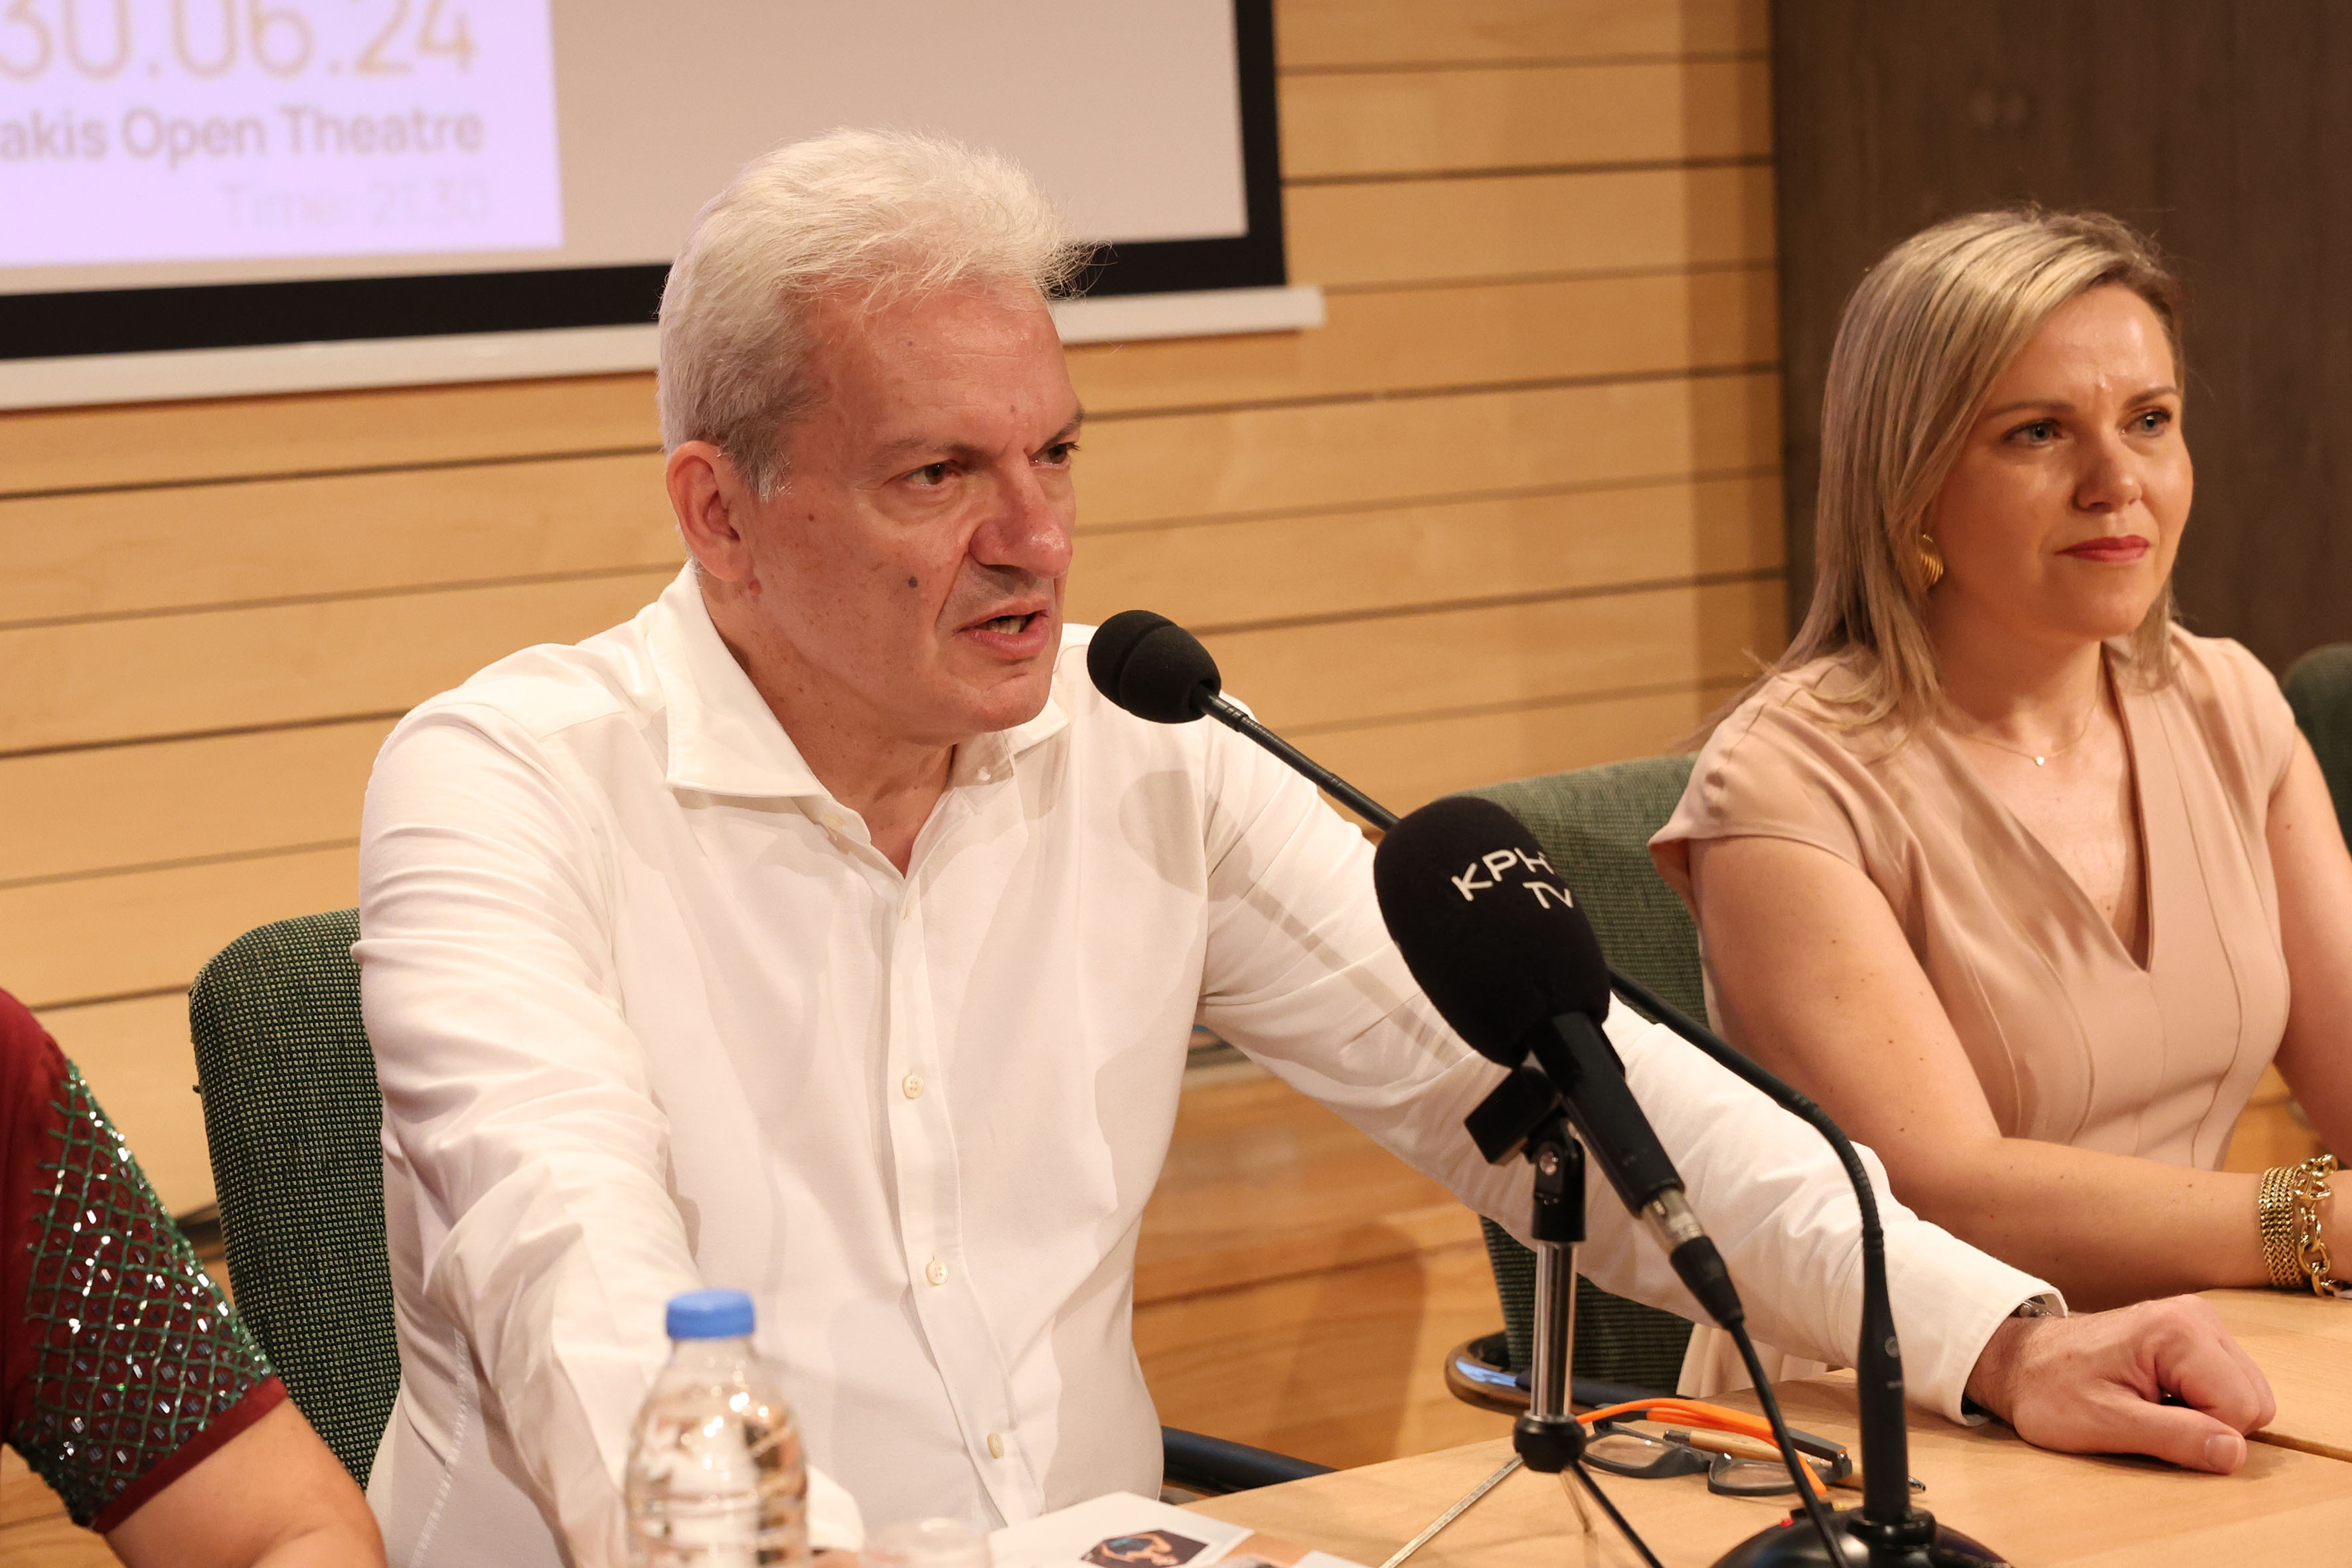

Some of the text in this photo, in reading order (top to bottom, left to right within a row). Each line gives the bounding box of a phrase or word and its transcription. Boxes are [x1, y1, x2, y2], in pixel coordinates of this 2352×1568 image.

[120, 105, 268, 170] Open
[277, 102, 485, 155] Theatre
[1522, 881, 1574, 909] TV
